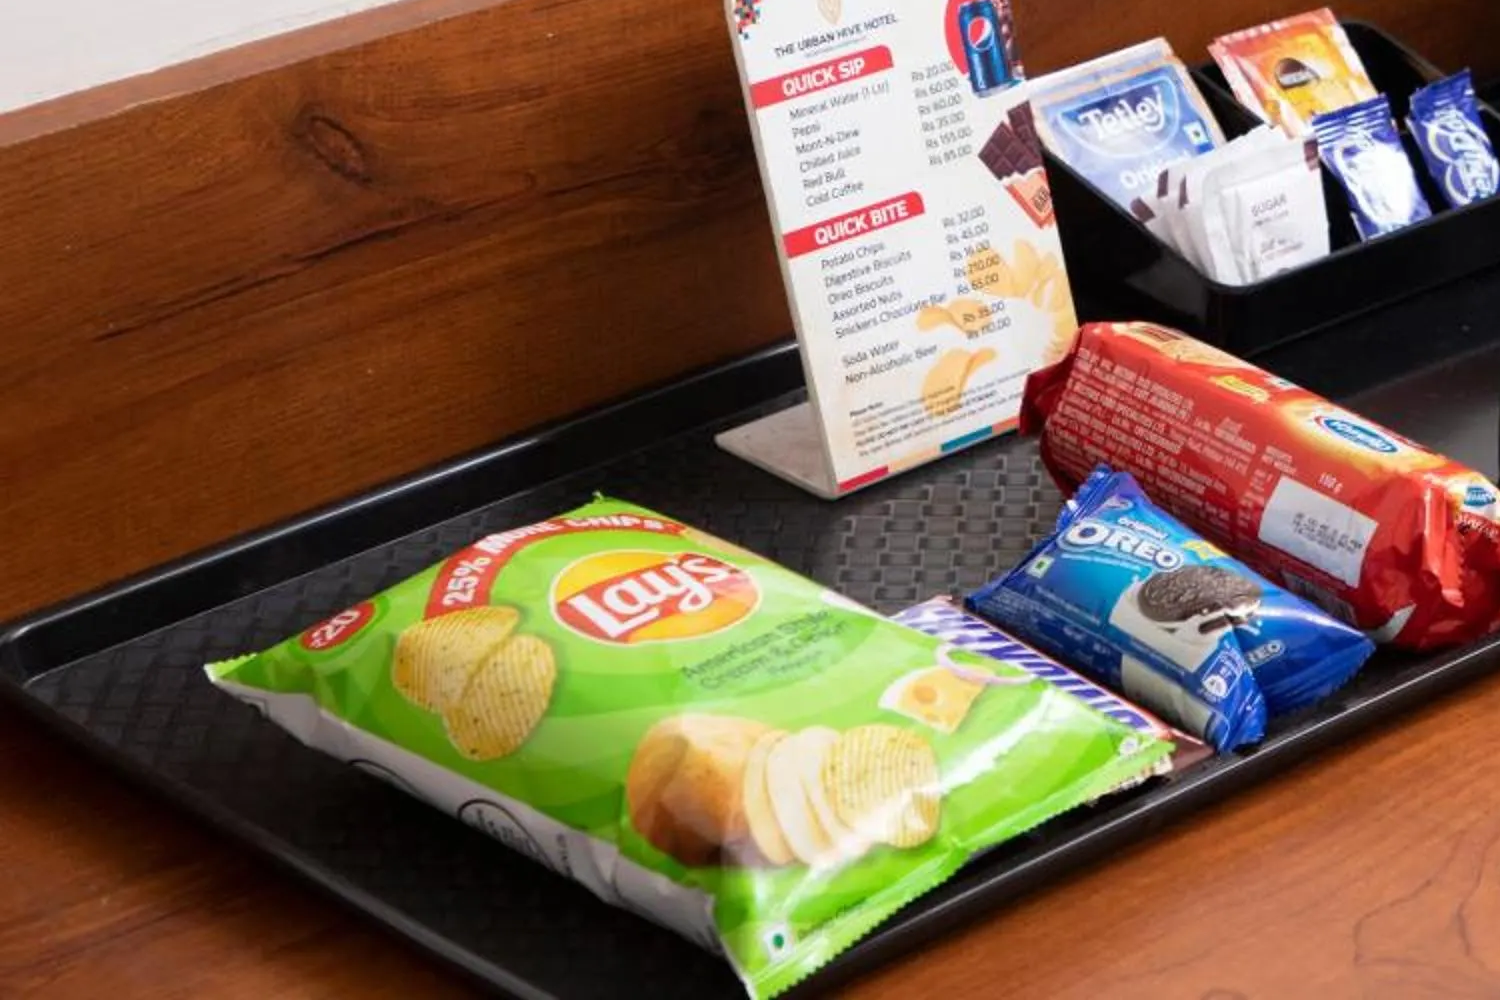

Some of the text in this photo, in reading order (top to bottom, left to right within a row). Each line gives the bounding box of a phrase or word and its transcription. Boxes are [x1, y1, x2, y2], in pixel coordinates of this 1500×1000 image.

[774, 43, 795, 58] THE
[798, 32, 835, 51] URBAN
[836, 23, 861, 38] HIVE
[863, 14, 898, 31] HOTEL
[781, 57, 865, 97] QUICK SIP
[792, 122, 821, 139] Pepsi
[1077, 85, 1166, 141] Tetley
[805, 190, 830, 207] Cold
[832, 181, 864, 199] Coffee
[814, 201, 909, 245] QUICK BITE
[821, 252, 855, 270] Potato
[856, 242, 885, 260] Chips
[824, 264, 870, 288] Digestive
[873, 250, 912, 271] Biscuits
[827, 289, 853, 305] Oreo
[854, 274, 895, 296] Biscuits
[831, 299, 877, 323] Assorted
[878, 290, 903, 305] Nuts
[835, 315, 878, 339] Snickers
[842, 350, 868, 368] Soda
[869, 339, 900, 357] Water
[1064, 519, 1180, 569] OREO
[443, 556, 491, 606] 25%
[567, 557, 734, 638] Lay's
